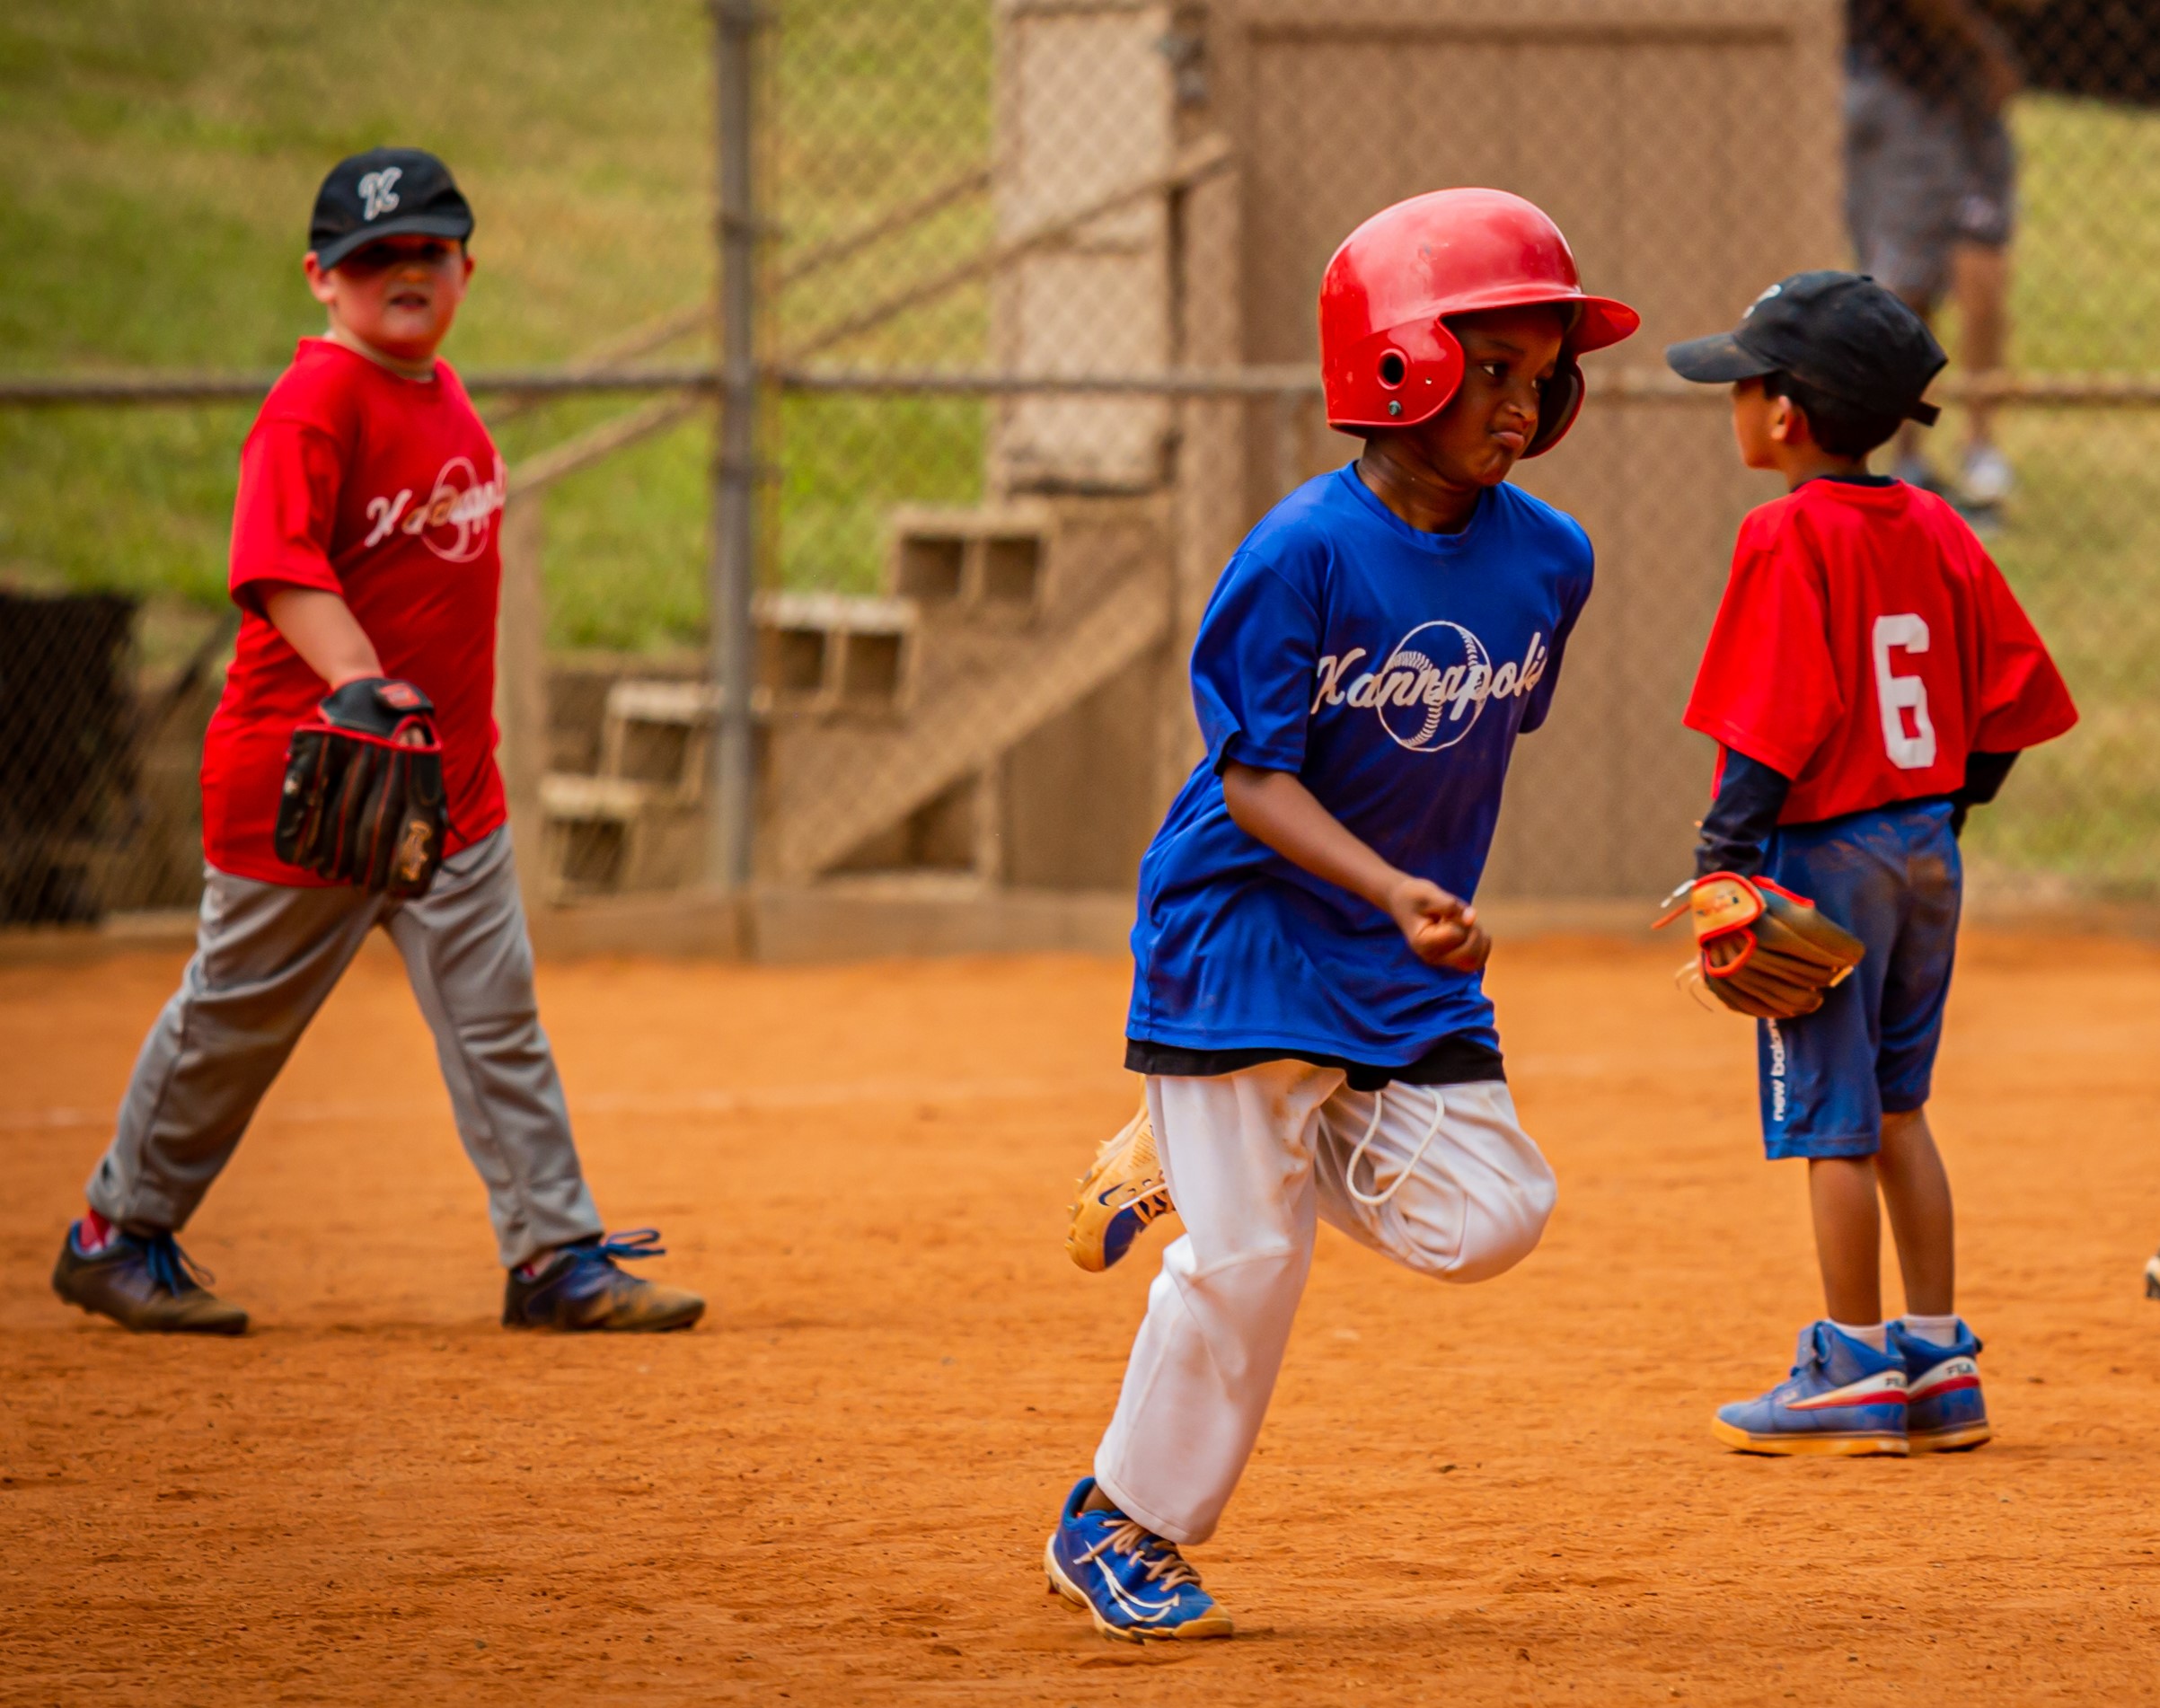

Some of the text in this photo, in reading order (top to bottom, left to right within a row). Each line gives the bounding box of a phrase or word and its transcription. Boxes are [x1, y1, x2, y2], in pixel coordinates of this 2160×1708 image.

[358, 166, 403, 222] K
[1873, 612, 1937, 770] 6
[1773, 1079, 1786, 1122] new
